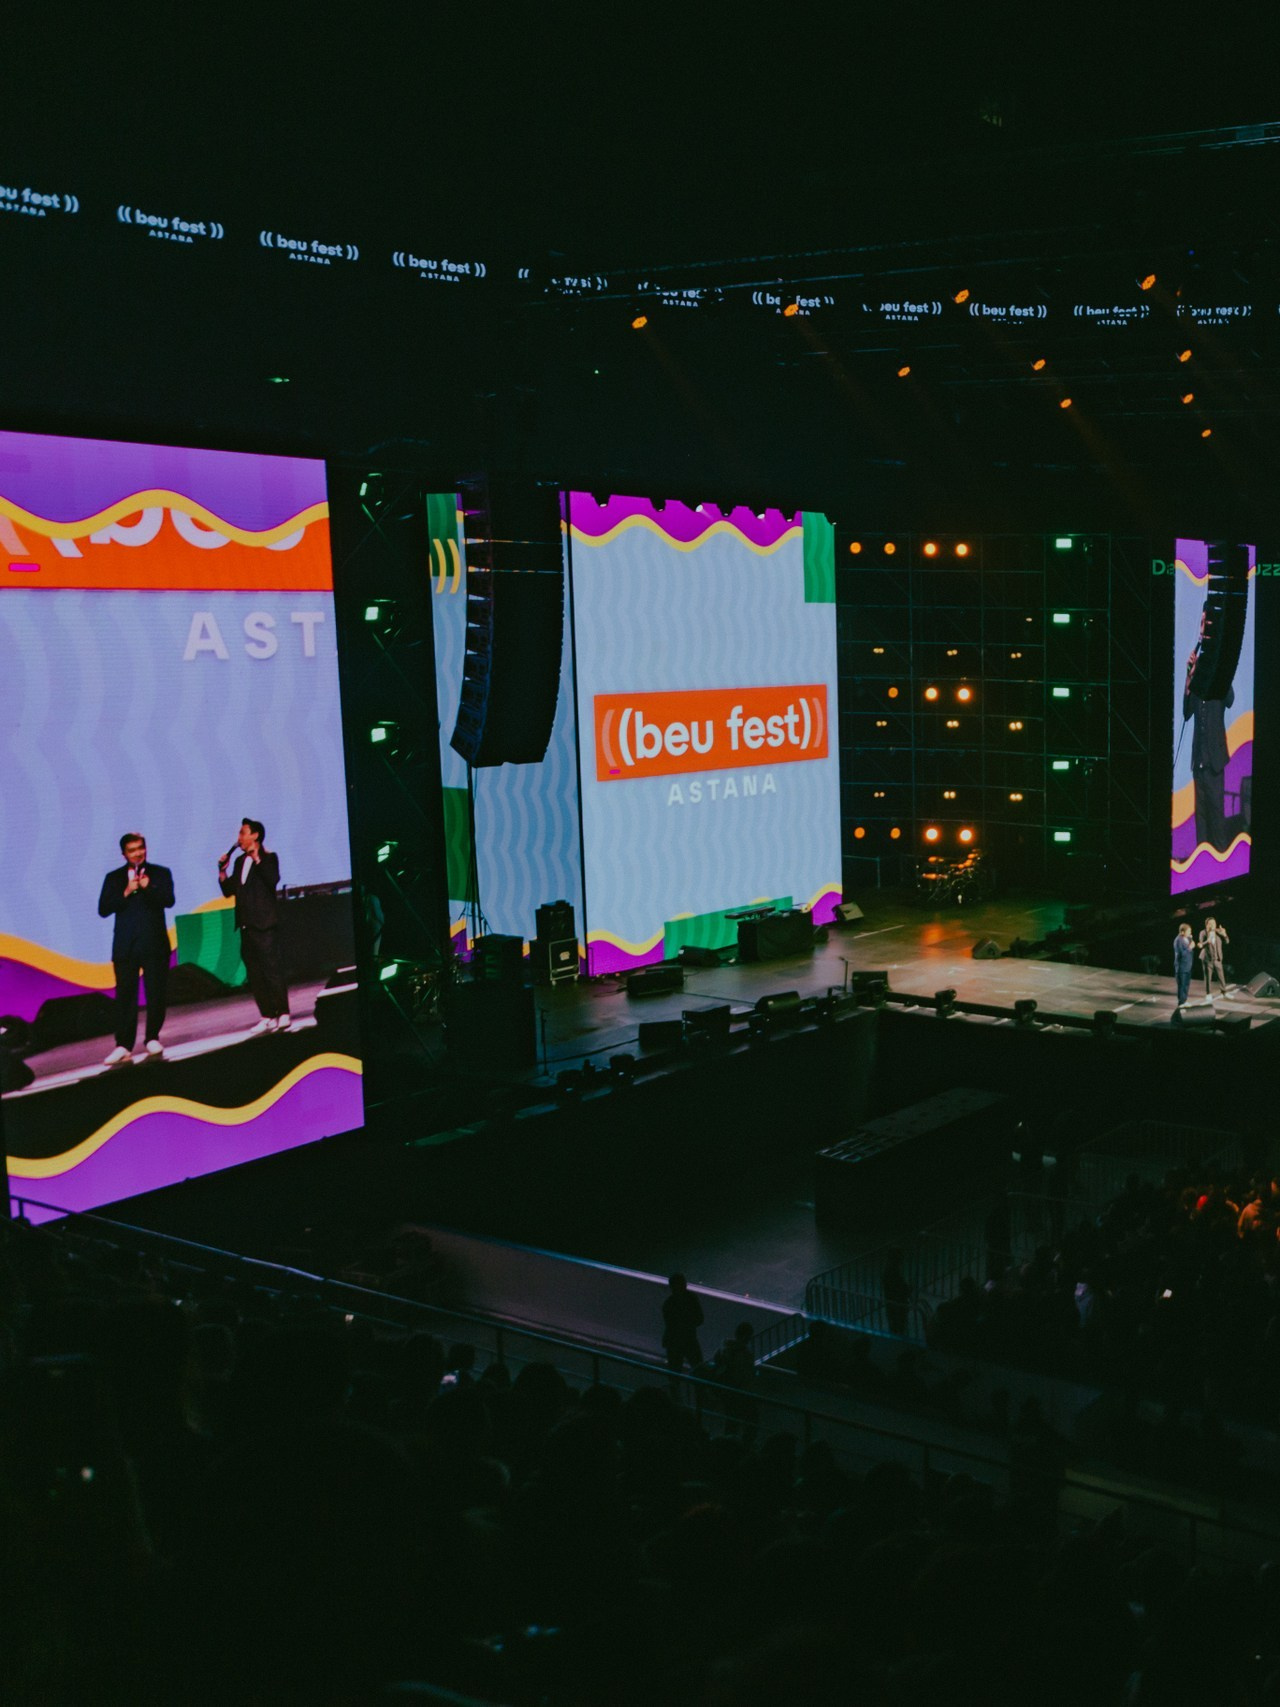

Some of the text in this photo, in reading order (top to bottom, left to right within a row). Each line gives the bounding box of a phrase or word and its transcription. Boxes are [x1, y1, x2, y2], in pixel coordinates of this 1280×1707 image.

[21, 187, 60, 209] fest
[135, 208, 207, 236] beu fest
[148, 229, 194, 244] ASTANA
[276, 234, 343, 258] beu fest
[288, 252, 331, 265] ASTANA
[408, 254, 471, 275] beu fest
[420, 271, 460, 282] ASTANA
[662, 298, 699, 308] ASTANA
[796, 295, 821, 308] fest
[904, 301, 929, 313] fest
[982, 304, 1035, 317] beu fest
[667, 773, 777, 806] ASTANA
